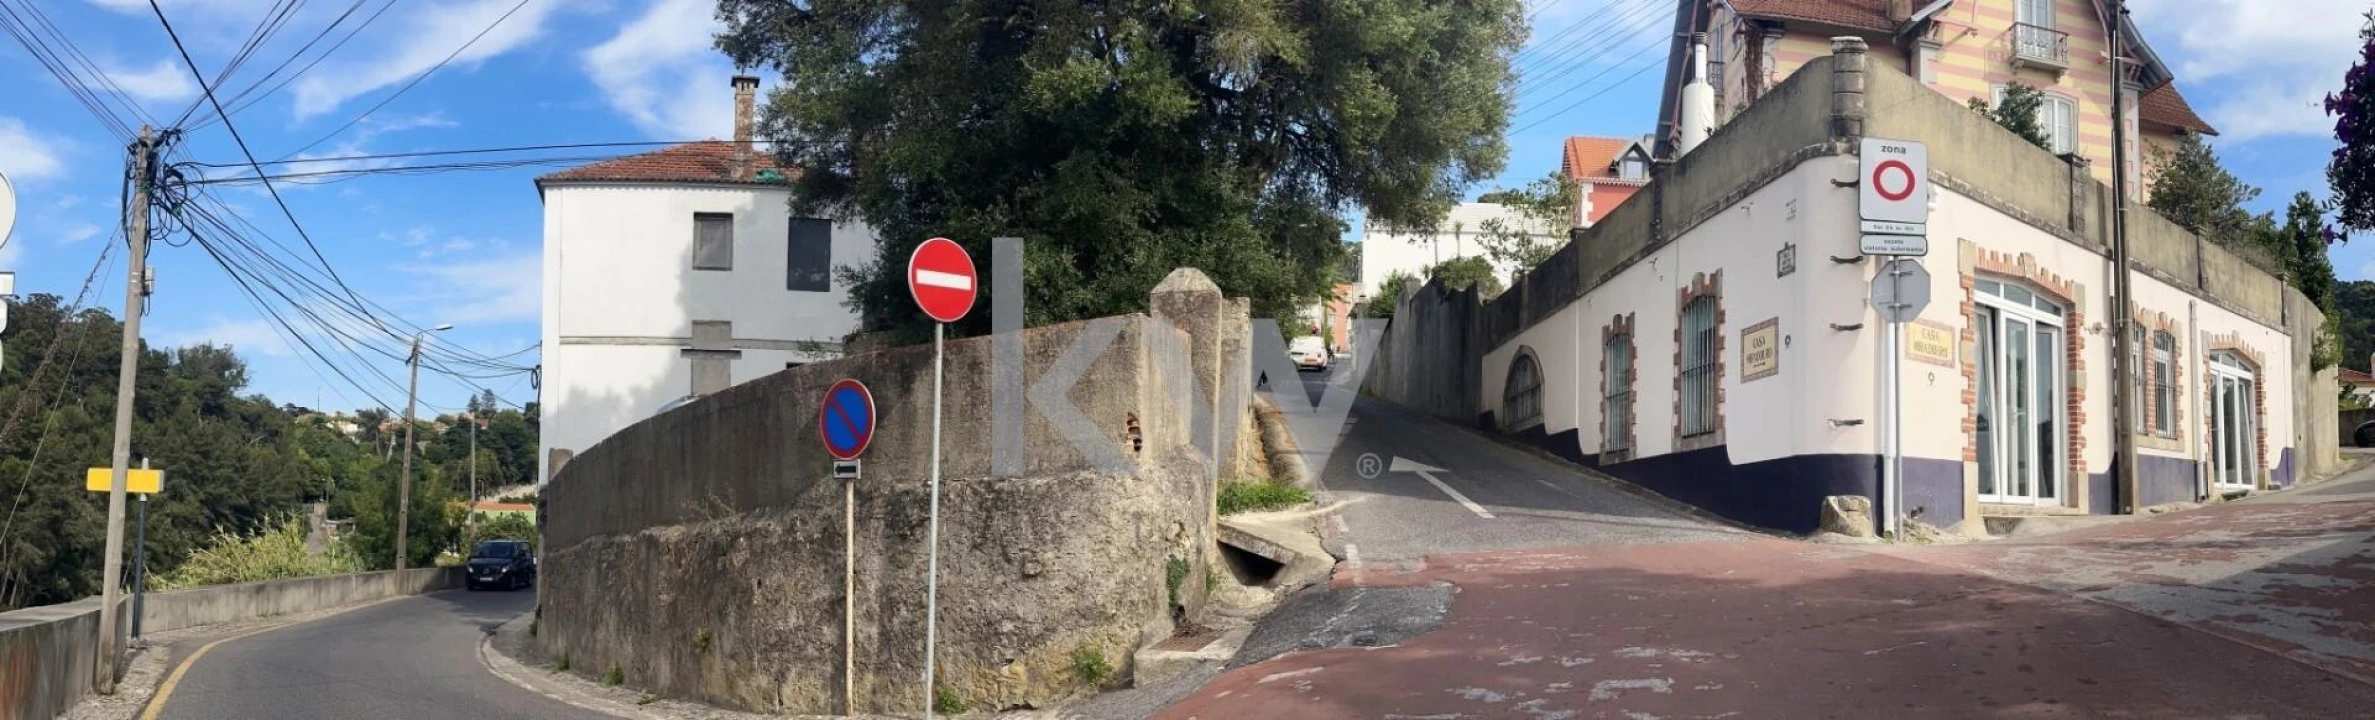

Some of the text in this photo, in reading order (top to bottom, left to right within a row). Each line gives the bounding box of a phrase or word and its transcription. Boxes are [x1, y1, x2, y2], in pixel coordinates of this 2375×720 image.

[1880, 145, 1907, 155] zona
[1922, 328, 1941, 343] CASA
[1752, 336, 1766, 348] CASA
